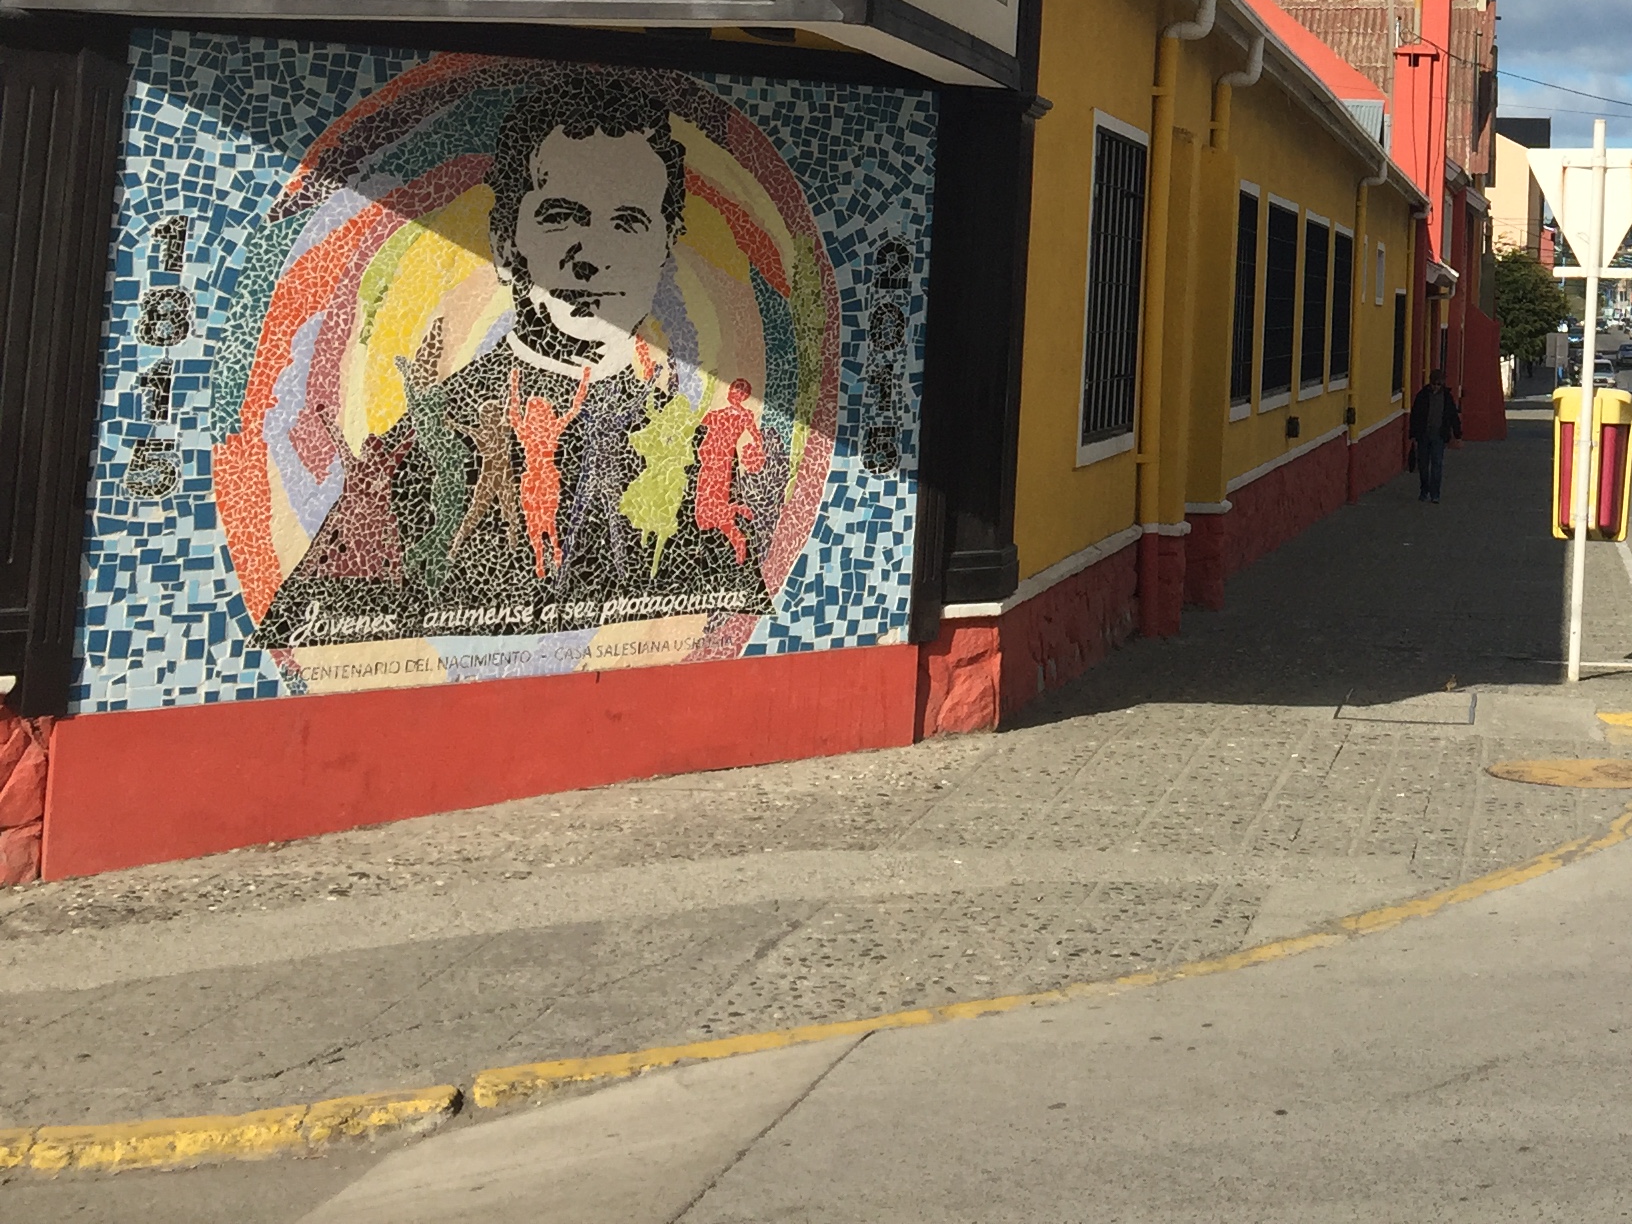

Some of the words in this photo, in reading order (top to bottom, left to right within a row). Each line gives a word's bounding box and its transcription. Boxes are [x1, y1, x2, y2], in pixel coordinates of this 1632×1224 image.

[541, 604, 558, 622] a
[564, 600, 599, 618] ser
[601, 590, 747, 625] protagonistas
[405, 658, 433, 673] DEL
[437, 650, 532, 671] NACIMIENTO
[554, 645, 592, 661] CASA
[596, 639, 670, 658] SALESIANA
